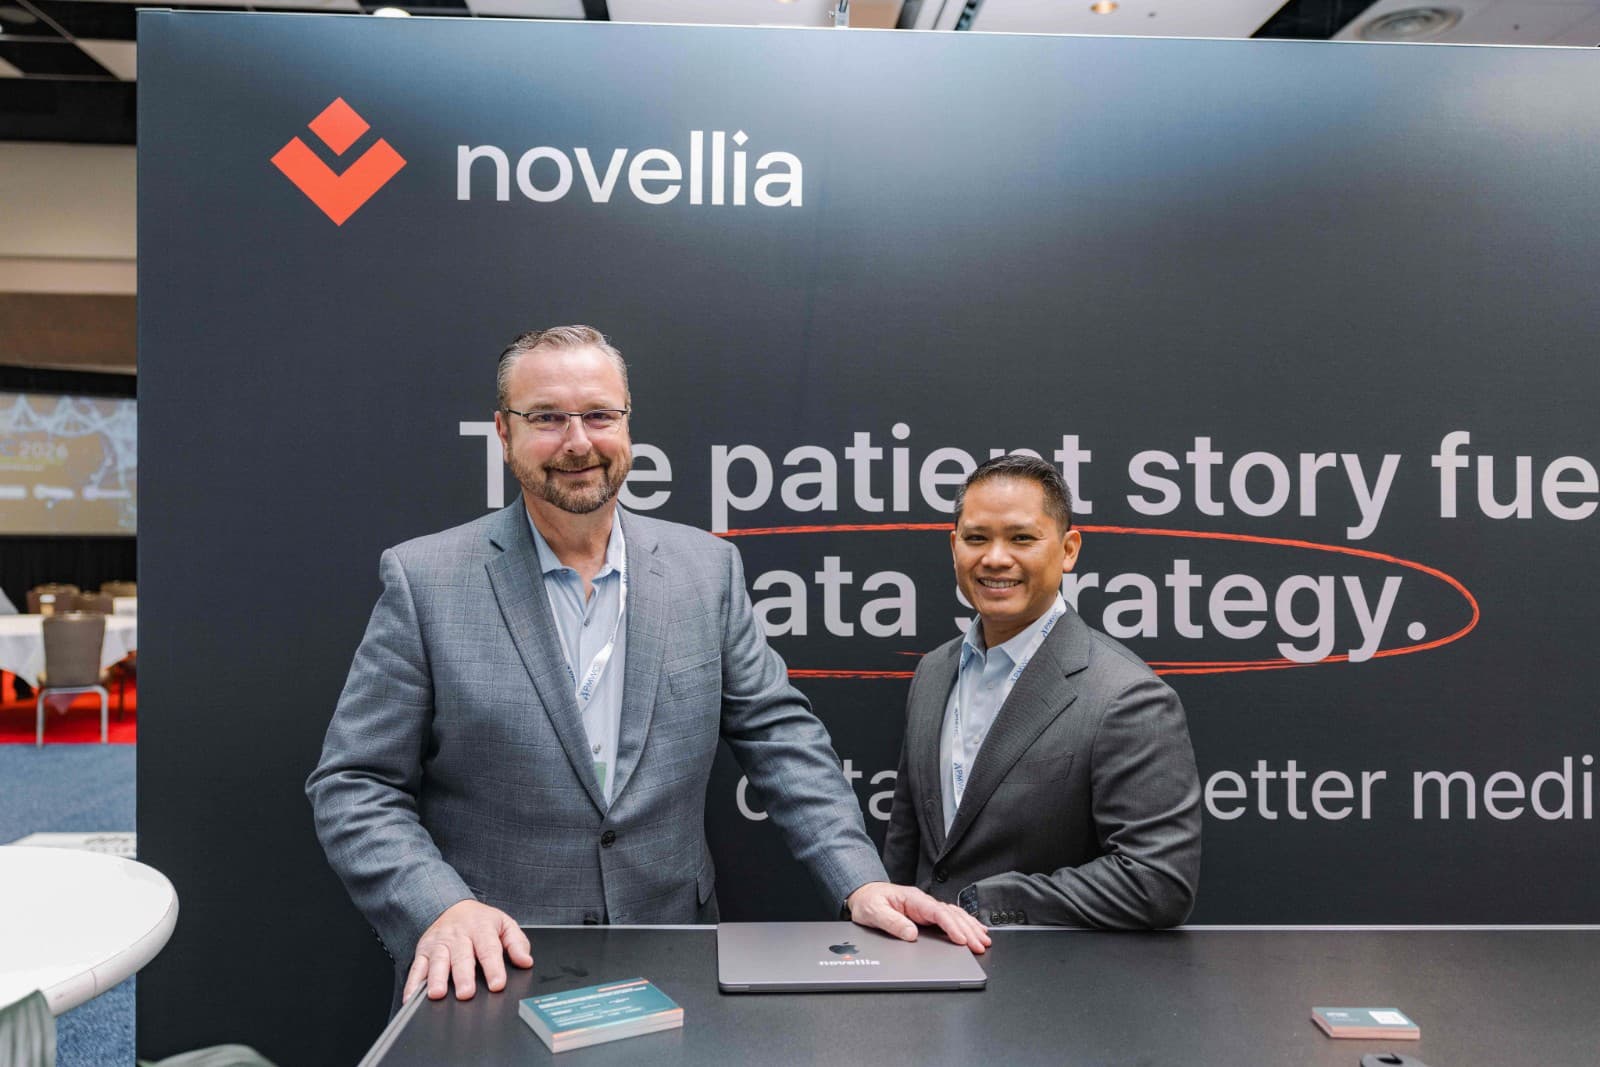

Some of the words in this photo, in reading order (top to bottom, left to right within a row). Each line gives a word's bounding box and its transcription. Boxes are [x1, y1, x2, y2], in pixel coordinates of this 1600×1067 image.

[457, 130, 803, 207] novellia
[459, 421, 673, 511] Te
[711, 422, 1092, 533] patiet
[1126, 436, 1402, 540] story
[1431, 430, 1600, 520] fue
[752, 556, 917, 638] ata
[953, 559, 1427, 664] rategy.
[1204, 759, 1387, 820] etter
[1413, 754, 1593, 820] medi
